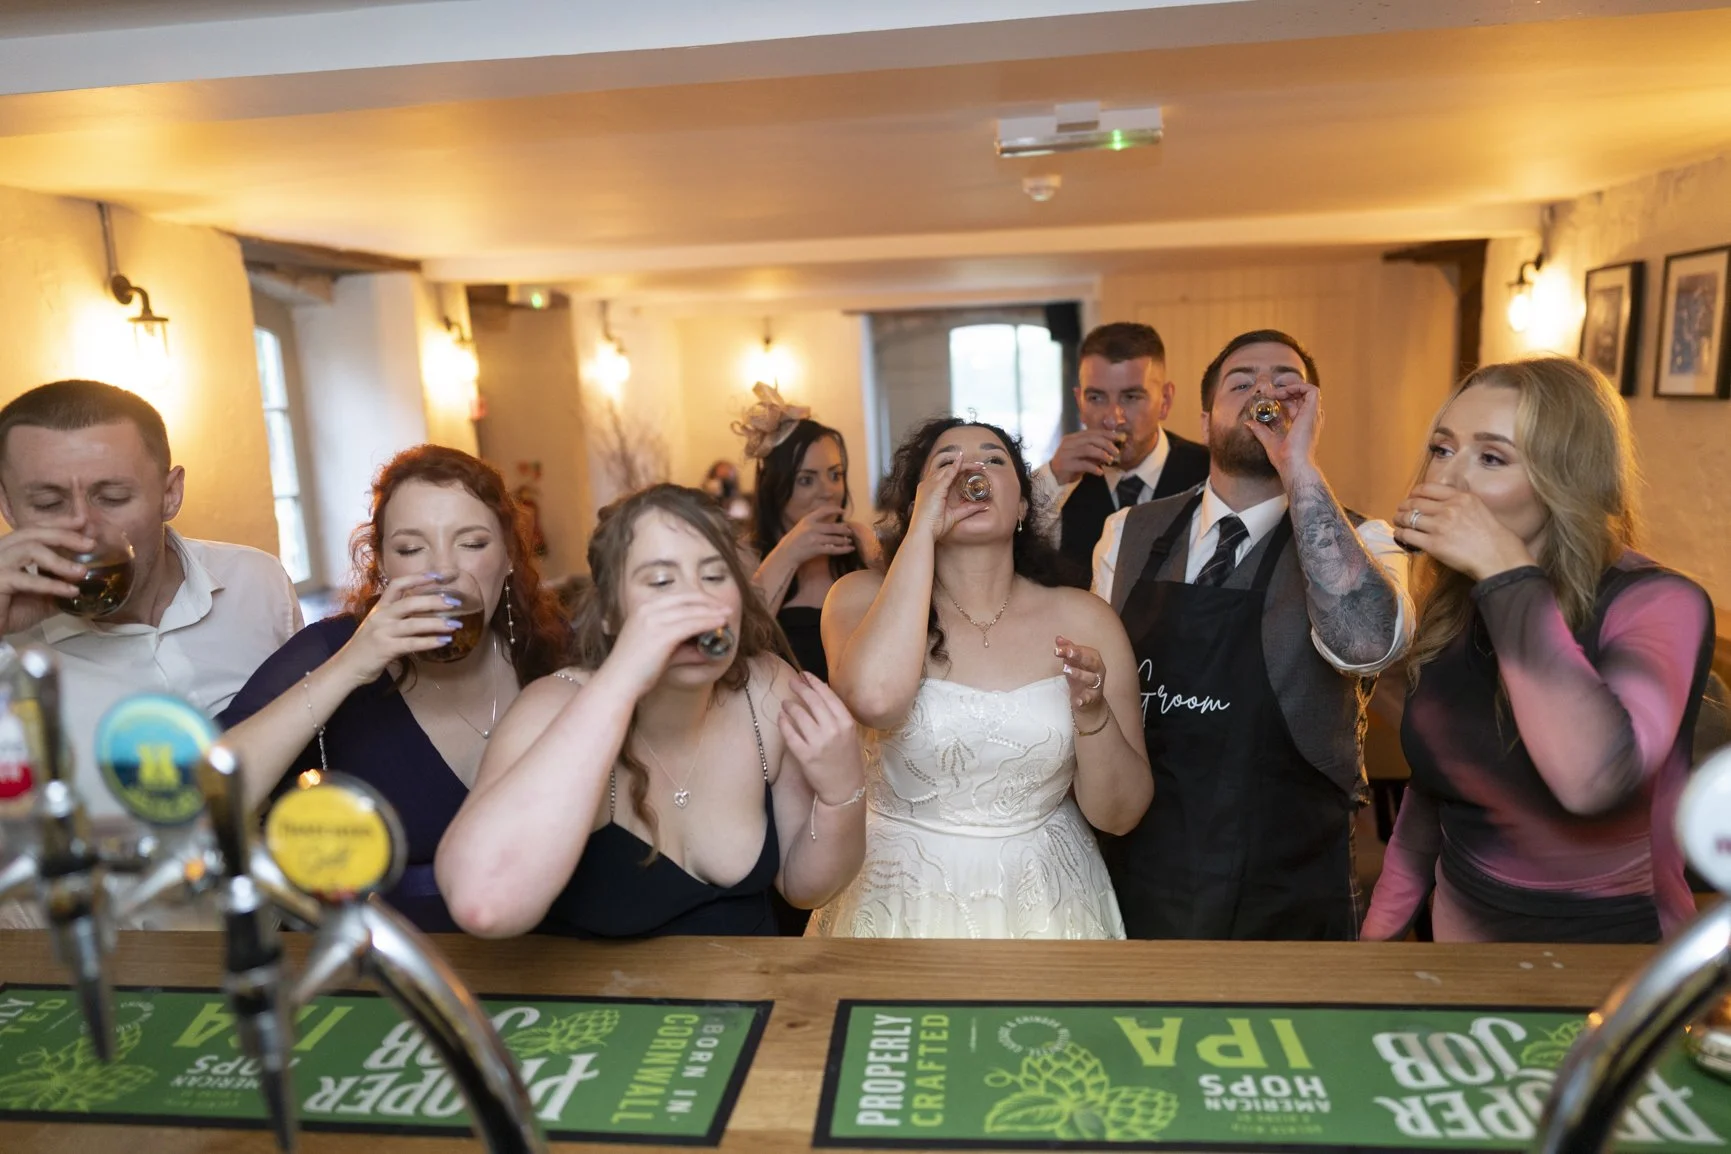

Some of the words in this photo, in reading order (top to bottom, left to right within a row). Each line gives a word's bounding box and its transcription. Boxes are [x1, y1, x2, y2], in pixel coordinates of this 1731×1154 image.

[1137, 658, 1230, 728] Groom
[186, 1055, 301, 1076] OPS
[611, 1013, 700, 1124] CORNWALL
[681, 1023, 725, 1078] BORN
[855, 1013, 913, 1127] PROPERLY
[910, 1014, 950, 1127] CRAFTED
[1112, 1016, 1315, 1070] IPA
[1371, 1016, 1528, 1091] JOB
[170, 1075, 263, 1090] MERICAN
[1198, 1074, 1328, 1099] HOPS
[1203, 1097, 1331, 1114] AMERICAN
